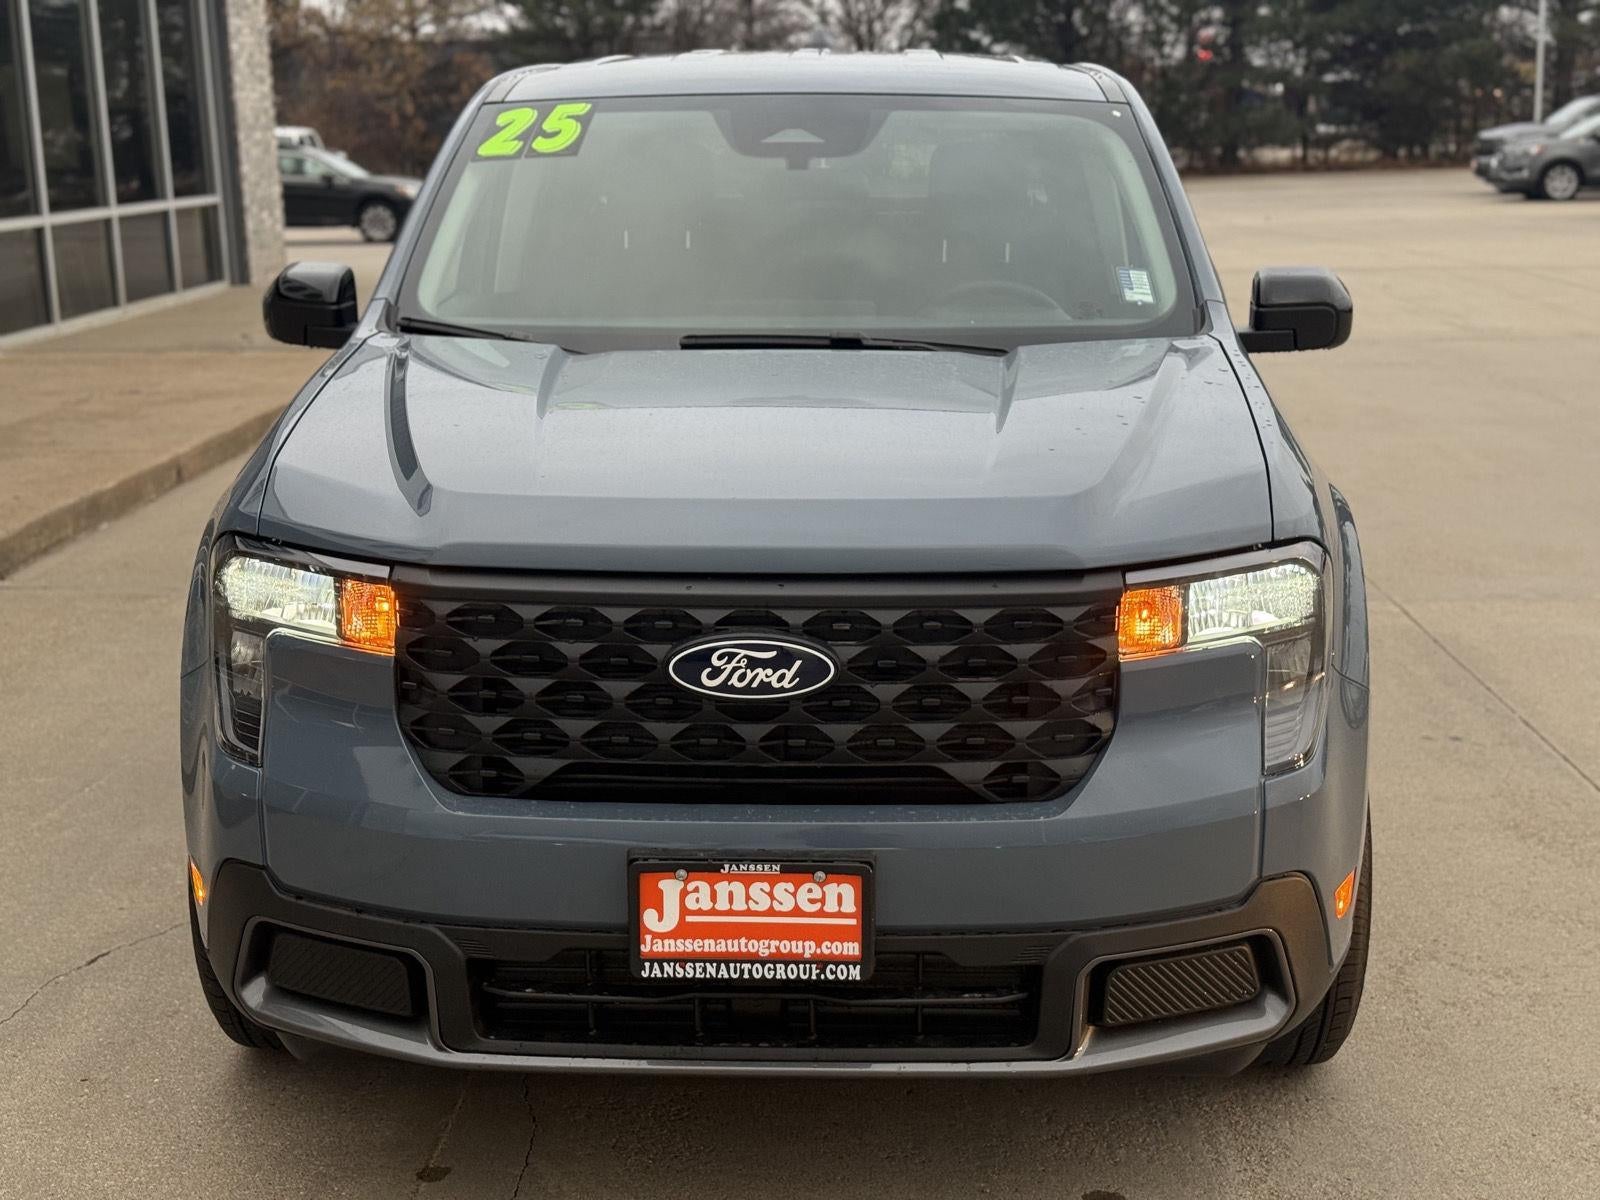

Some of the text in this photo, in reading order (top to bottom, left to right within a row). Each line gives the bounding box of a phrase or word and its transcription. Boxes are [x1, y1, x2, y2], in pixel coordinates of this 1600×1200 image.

[477, 103, 592, 157] 25
[701, 648, 802, 689] Ford
[720, 864, 780, 874] JANSSEN
[643, 879, 857, 933] Janssen
[640, 934, 860, 958] Janssenautogroup.com
